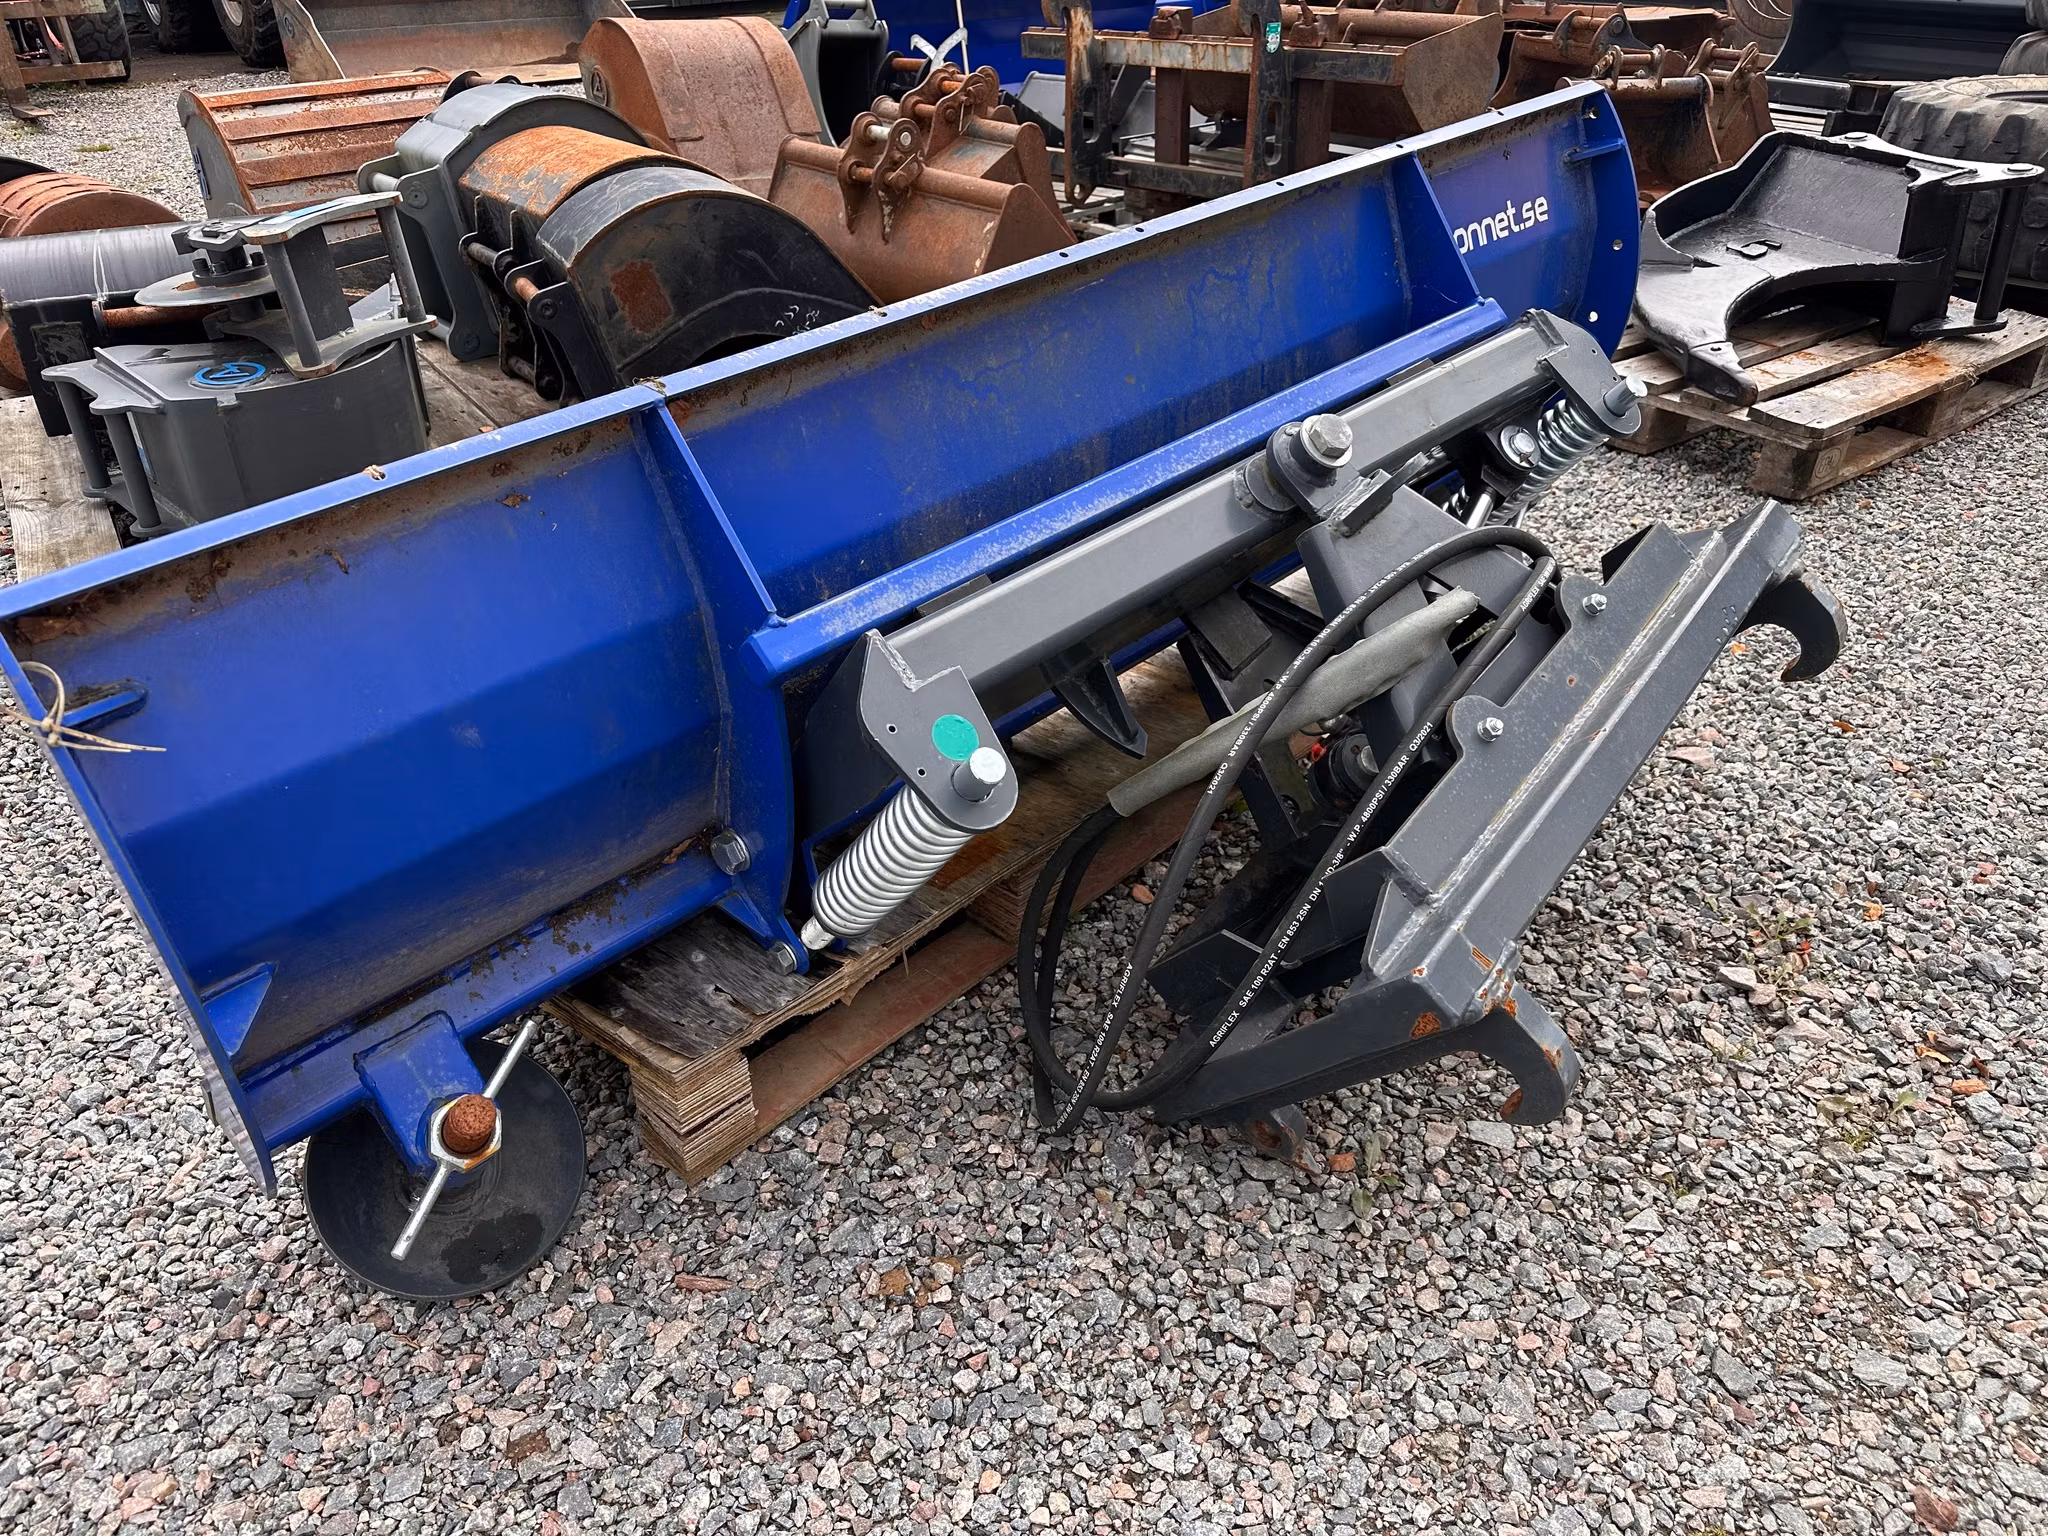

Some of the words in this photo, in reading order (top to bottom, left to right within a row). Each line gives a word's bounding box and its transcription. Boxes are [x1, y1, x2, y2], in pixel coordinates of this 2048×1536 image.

[1353, 595, 1367, 605] EN
[1329, 613, 1346, 627] 2SN
[1310, 638, 1321, 647] 10
[1317, 628, 1331, 640] DN
[1250, 691, 1275, 721] 4800PSI
[1227, 725, 1252, 757] 330BAR
[1206, 762, 1229, 795] Q3/2021
[1208, 1011, 1240, 1048] AGRIFLEX
[1238, 988, 1255, 1008] SAE
[1251, 973, 1266, 990] 100
[1260, 954, 1279, 976] R2AT
[1277, 935, 1291, 952] EN
[1287, 920, 1301, 938] 853
[1298, 903, 1312, 922] 2SN
[1309, 887, 1322, 902] DN
[1347, 824, 1364, 842] W.P.
[1360, 790, 1386, 824] 4800PSI
[1384, 754, 1410, 789] 330BAR
[1408, 721, 1435, 752] Q3/2021
[1111, 962, 1133, 1008] AGRIFLEX
[1102, 1011, 1114, 1030] SAE
[1096, 1029, 1106, 1046] 100
[1087, 1045, 1101, 1067] R2AT
[1081, 1069, 1090, 1081] EN
